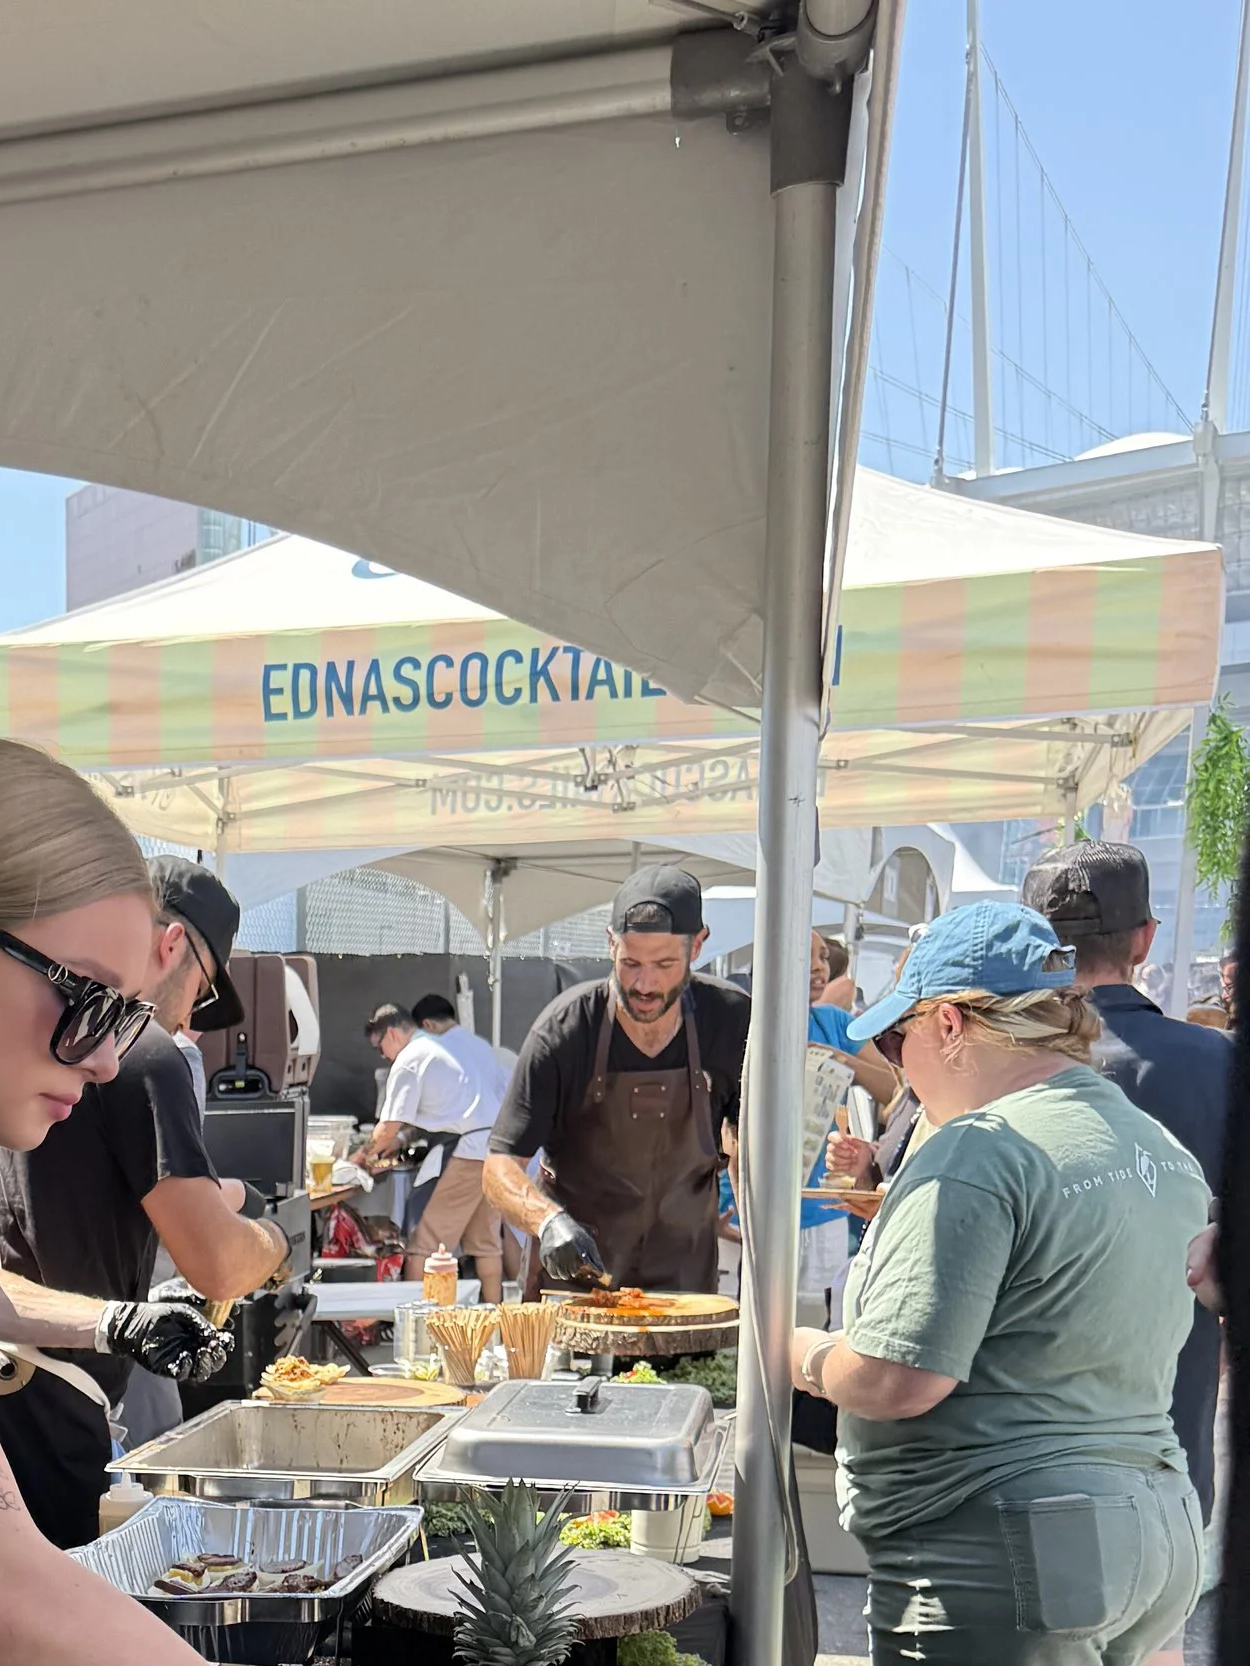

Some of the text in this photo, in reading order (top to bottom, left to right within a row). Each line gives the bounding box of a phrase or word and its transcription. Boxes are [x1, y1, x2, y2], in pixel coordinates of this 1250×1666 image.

[1062, 1176, 1103, 1198] FROM
[1109, 1167, 1133, 1183] TIDE
[1161, 1161, 1175, 1171] TO
